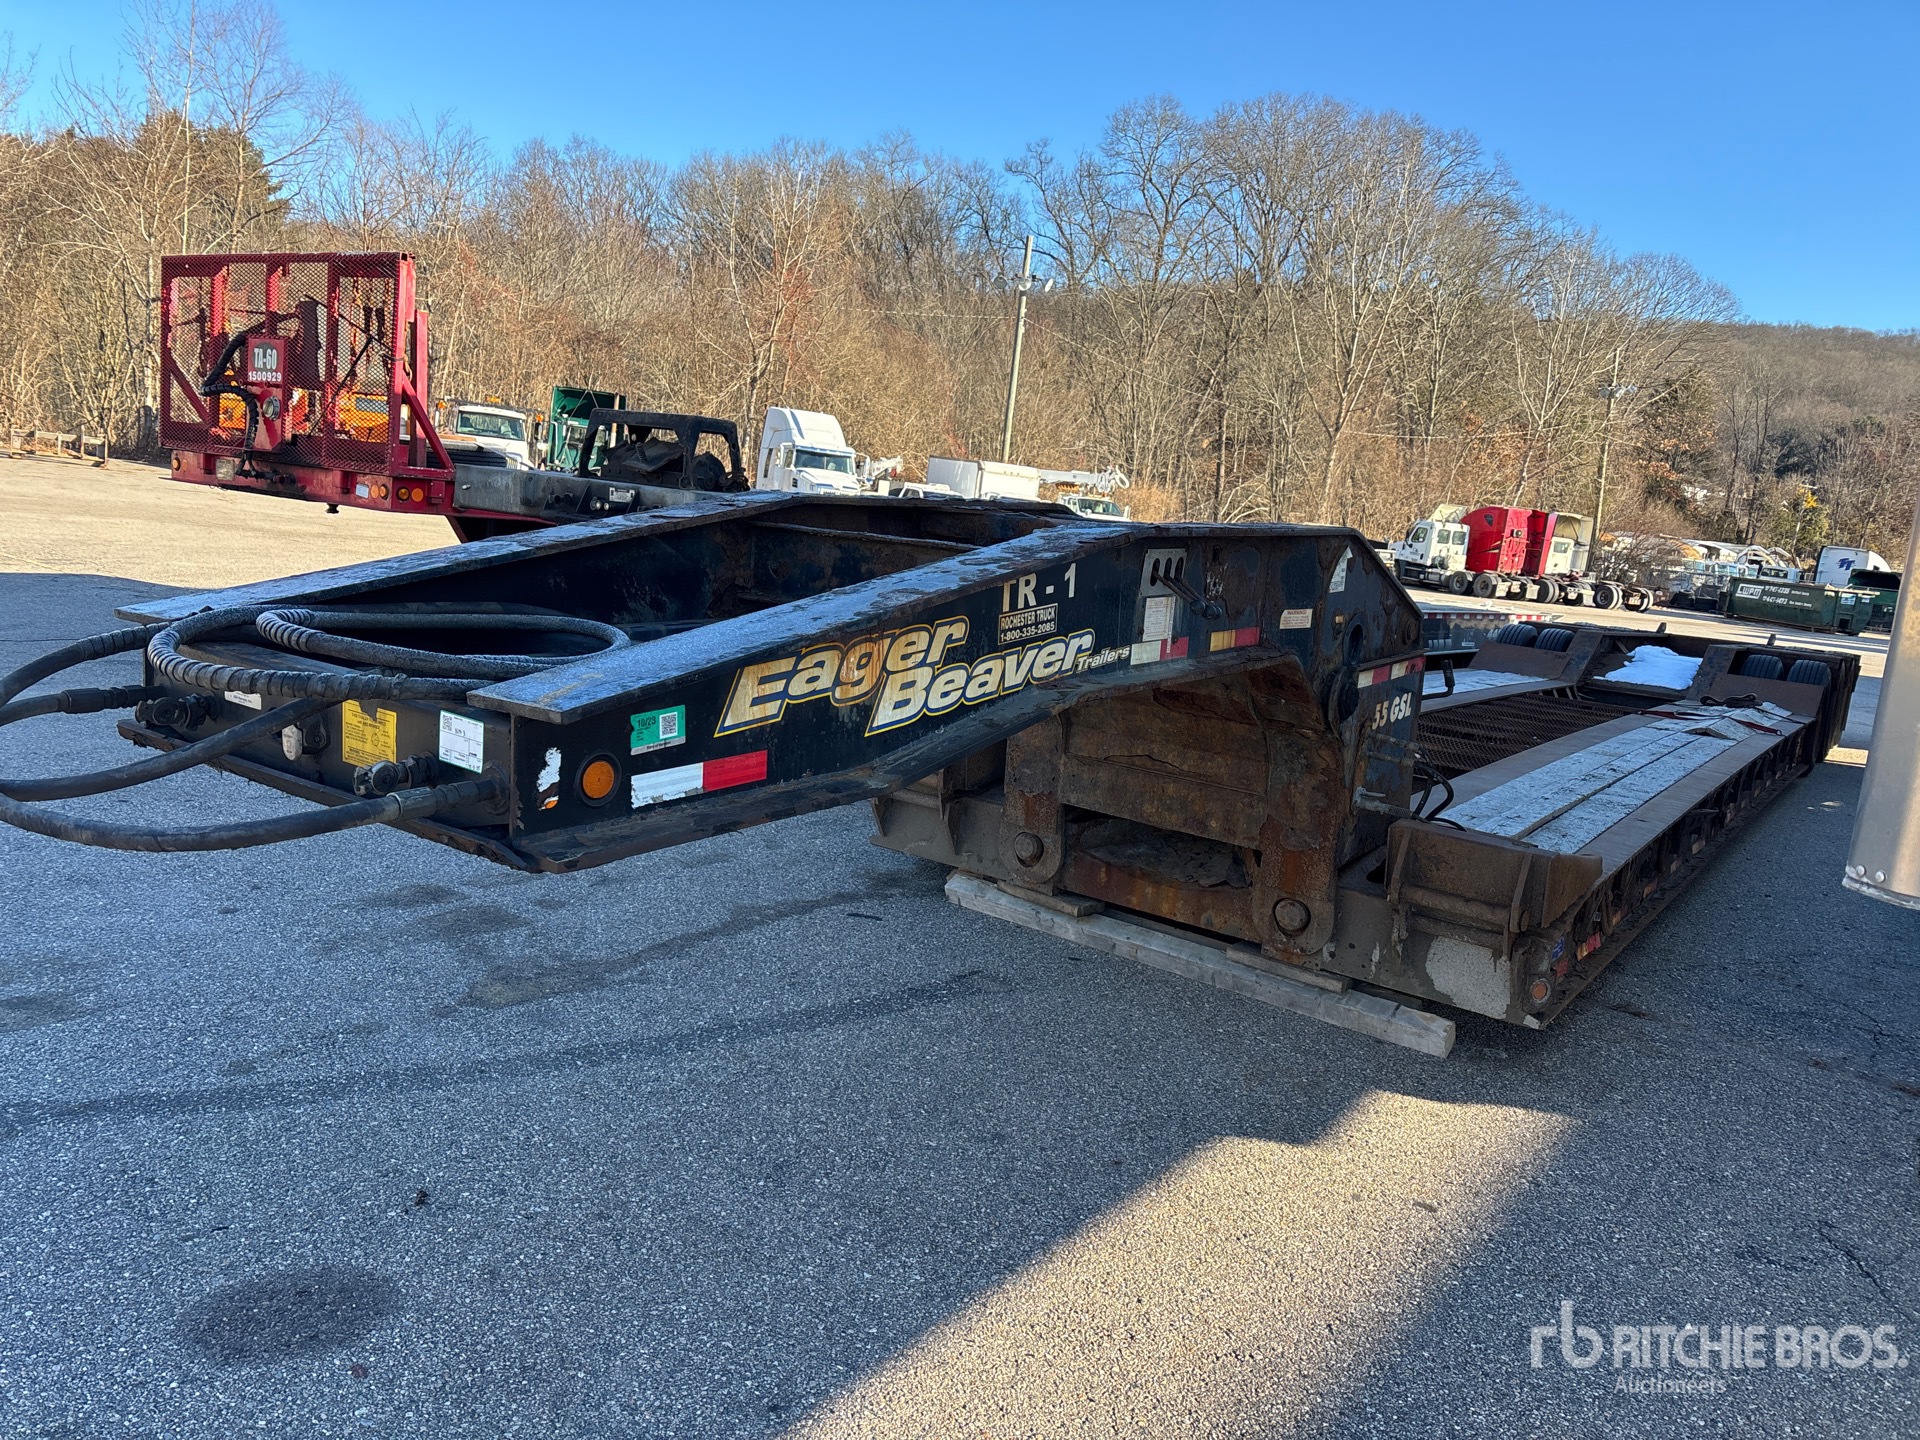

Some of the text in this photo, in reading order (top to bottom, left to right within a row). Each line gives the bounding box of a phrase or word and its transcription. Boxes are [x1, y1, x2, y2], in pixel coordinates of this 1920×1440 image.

[254, 348, 277, 370] TA-60
[249, 371, 282, 382] 1500929
[1001, 572, 1037, 612] TR
[1064, 562, 1076, 598] 1
[1000, 606, 1056, 631] ROCHESTER TRUCK
[1000, 621, 1055, 642] 1-800-335-2085
[714, 616, 970, 737] Eager
[864, 628, 1131, 737] Beaver Trailers
[637, 716, 657, 728] 10/23
[1371, 692, 1412, 730] 55 GSL
